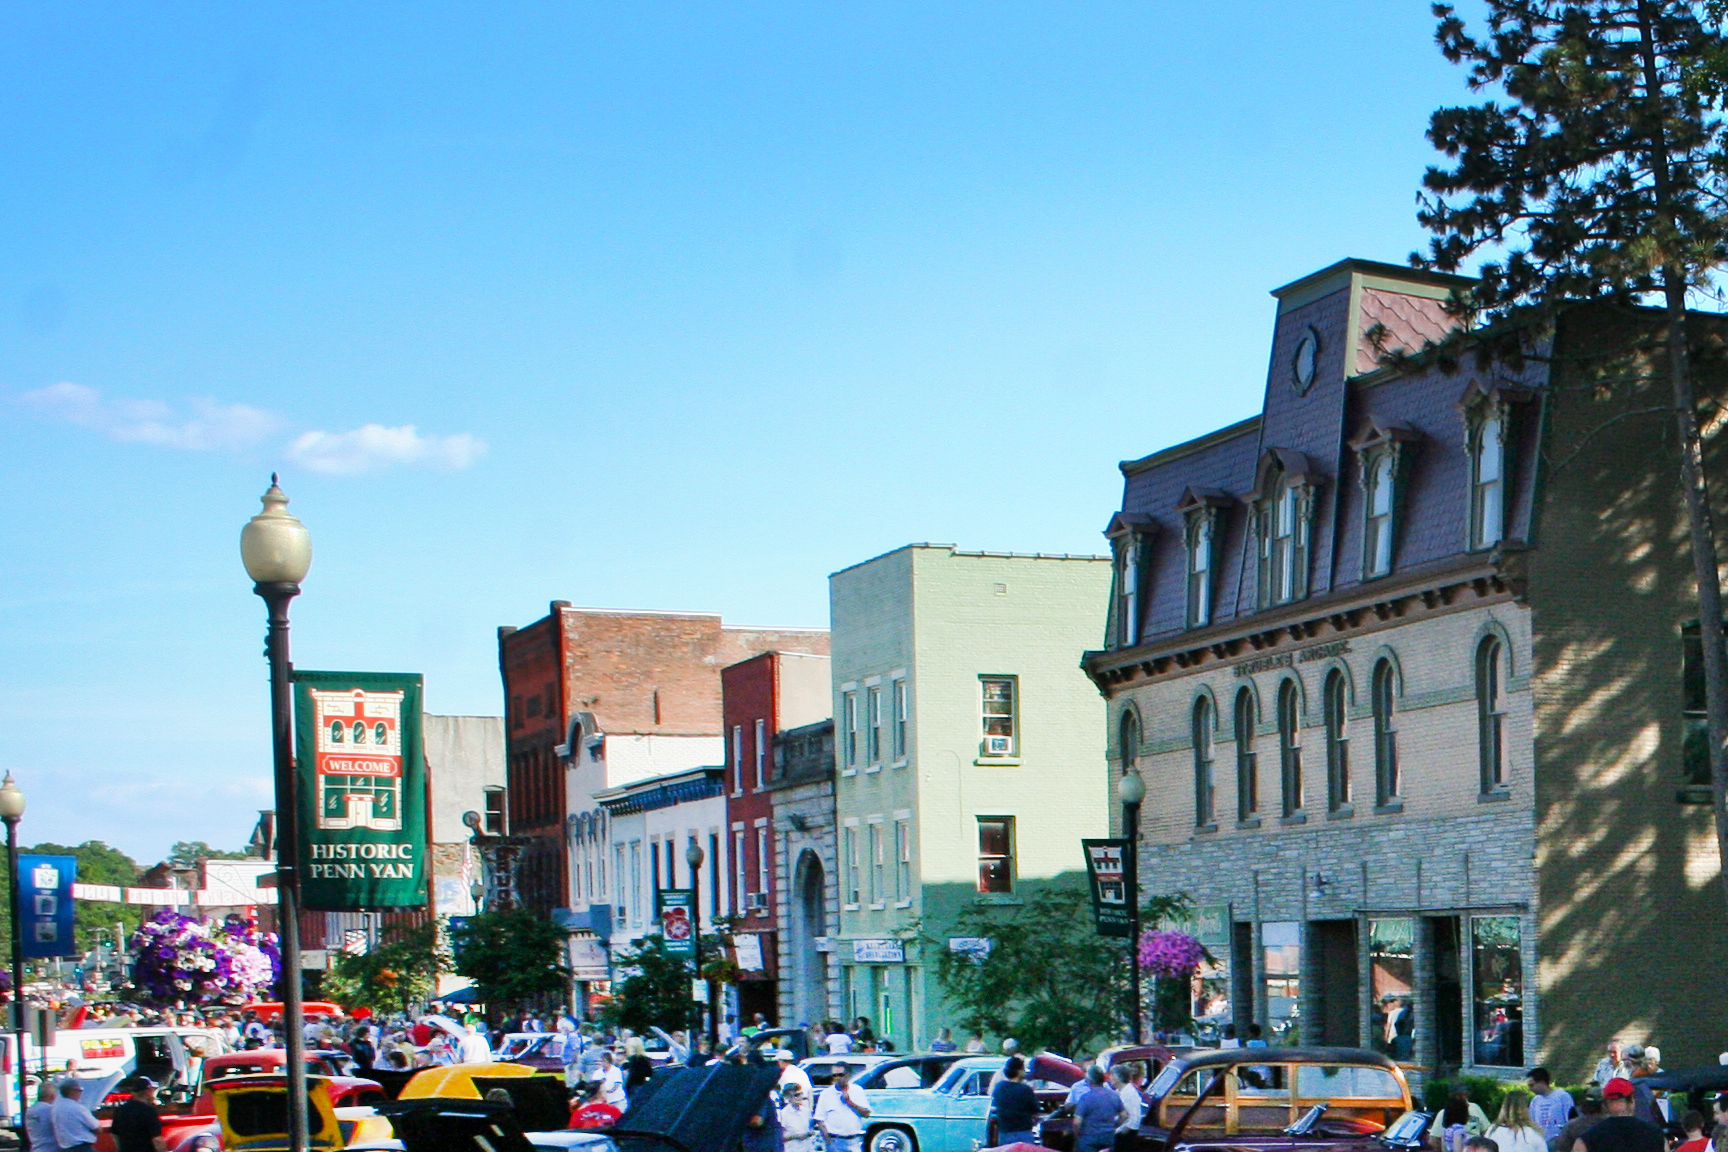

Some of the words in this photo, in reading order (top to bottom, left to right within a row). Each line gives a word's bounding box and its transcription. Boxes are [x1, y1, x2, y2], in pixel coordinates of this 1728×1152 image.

[329, 759, 391, 773] WELCOME
[311, 843, 413, 859] HISTORIC
[310, 863, 366, 879] PENN
[369, 863, 415, 879] YAN
